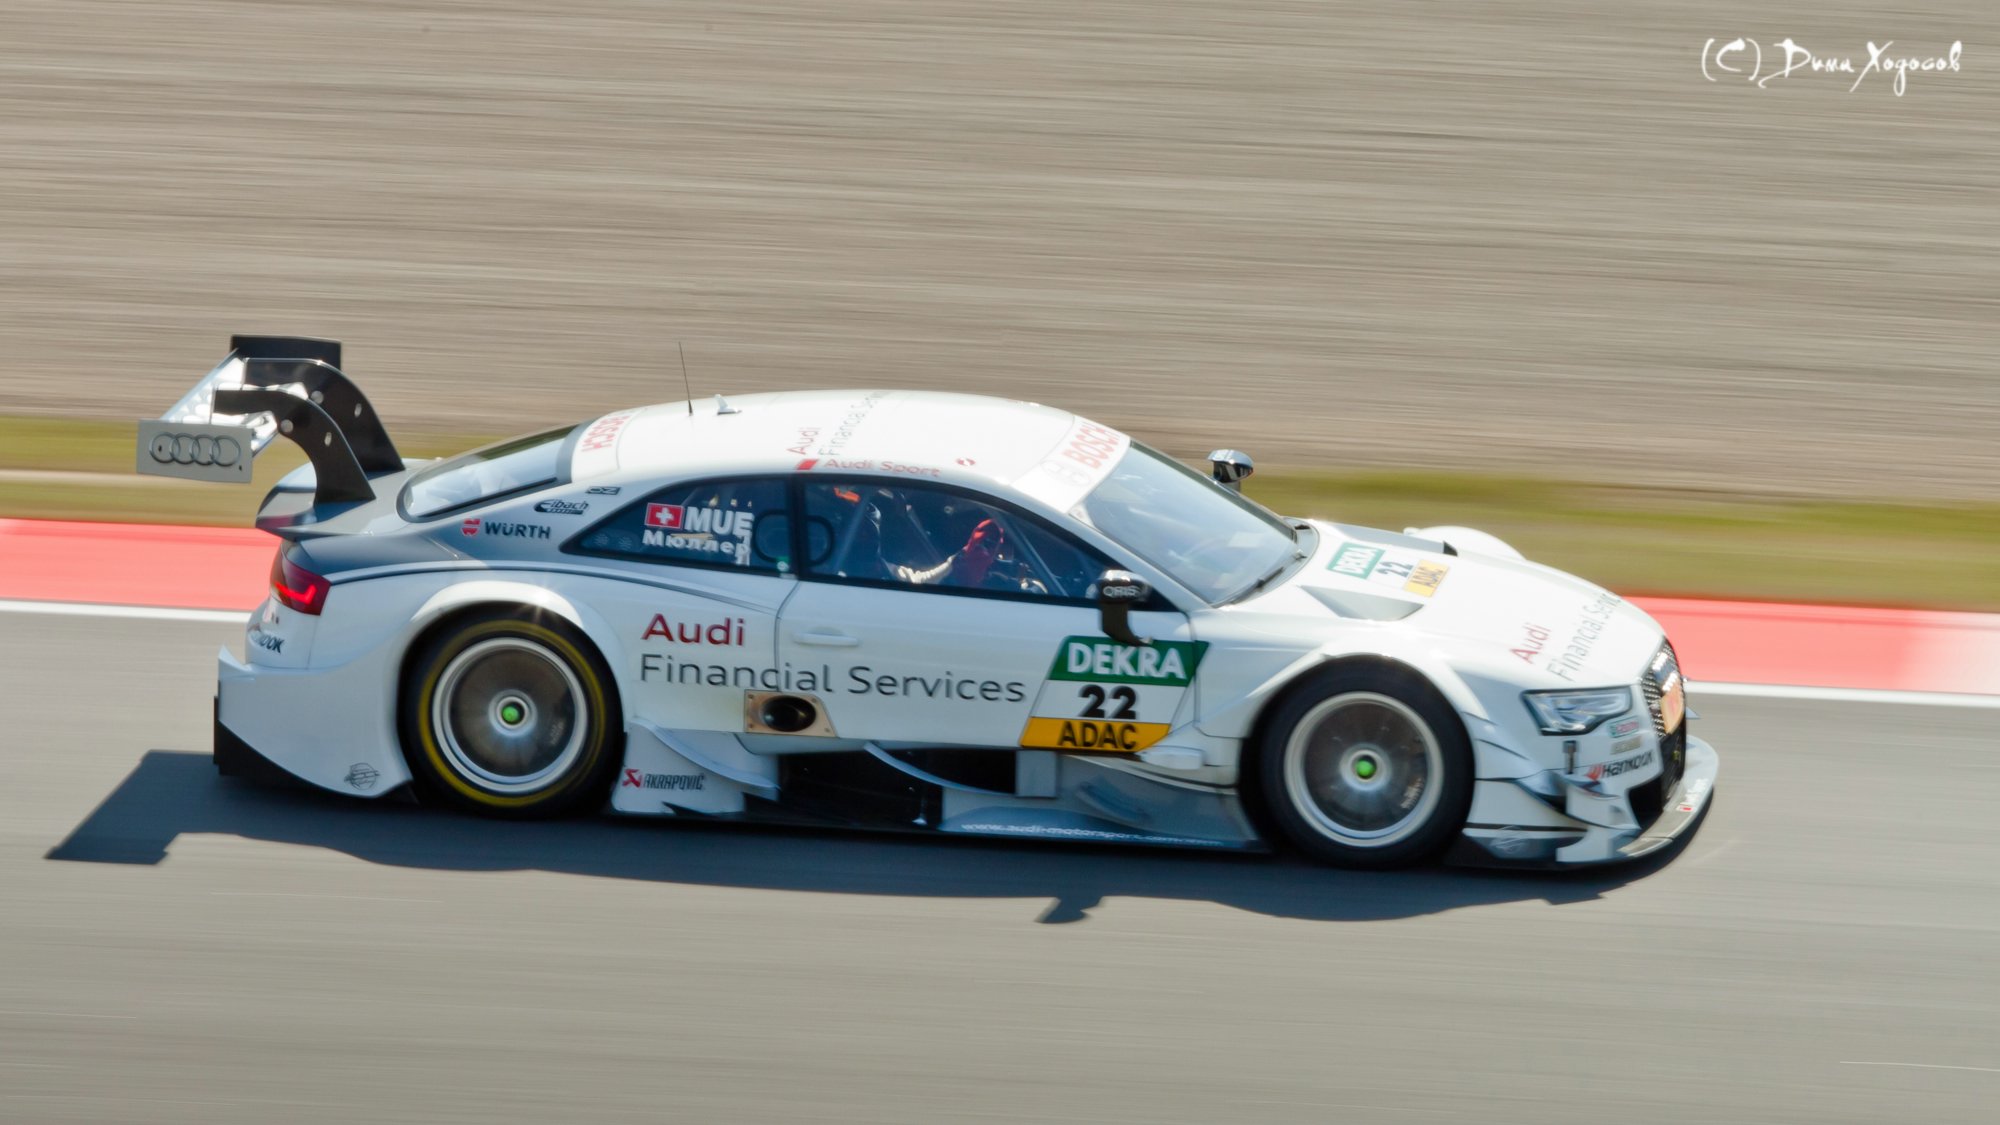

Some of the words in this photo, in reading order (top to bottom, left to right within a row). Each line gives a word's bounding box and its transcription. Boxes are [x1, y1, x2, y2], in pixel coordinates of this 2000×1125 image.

[785, 426, 822, 456] Audi
[1060, 420, 1121, 470] BOSCH
[823, 457, 875, 471] Audi
[879, 460, 942, 478] Sport
[484, 520, 551, 540] WÜRTH
[684, 505, 755, 538] MUE
[1375, 560, 1415, 578] 22
[640, 612, 746, 647] Audi
[1508, 621, 1553, 665] Audi
[1067, 641, 1188, 681] DEKRA
[1545, 614, 1606, 682] Financial
[640, 652, 833, 693] Financial
[847, 665, 1026, 703] Services
[1078, 684, 1138, 720] 22
[1057, 720, 1137, 750] ADAC
